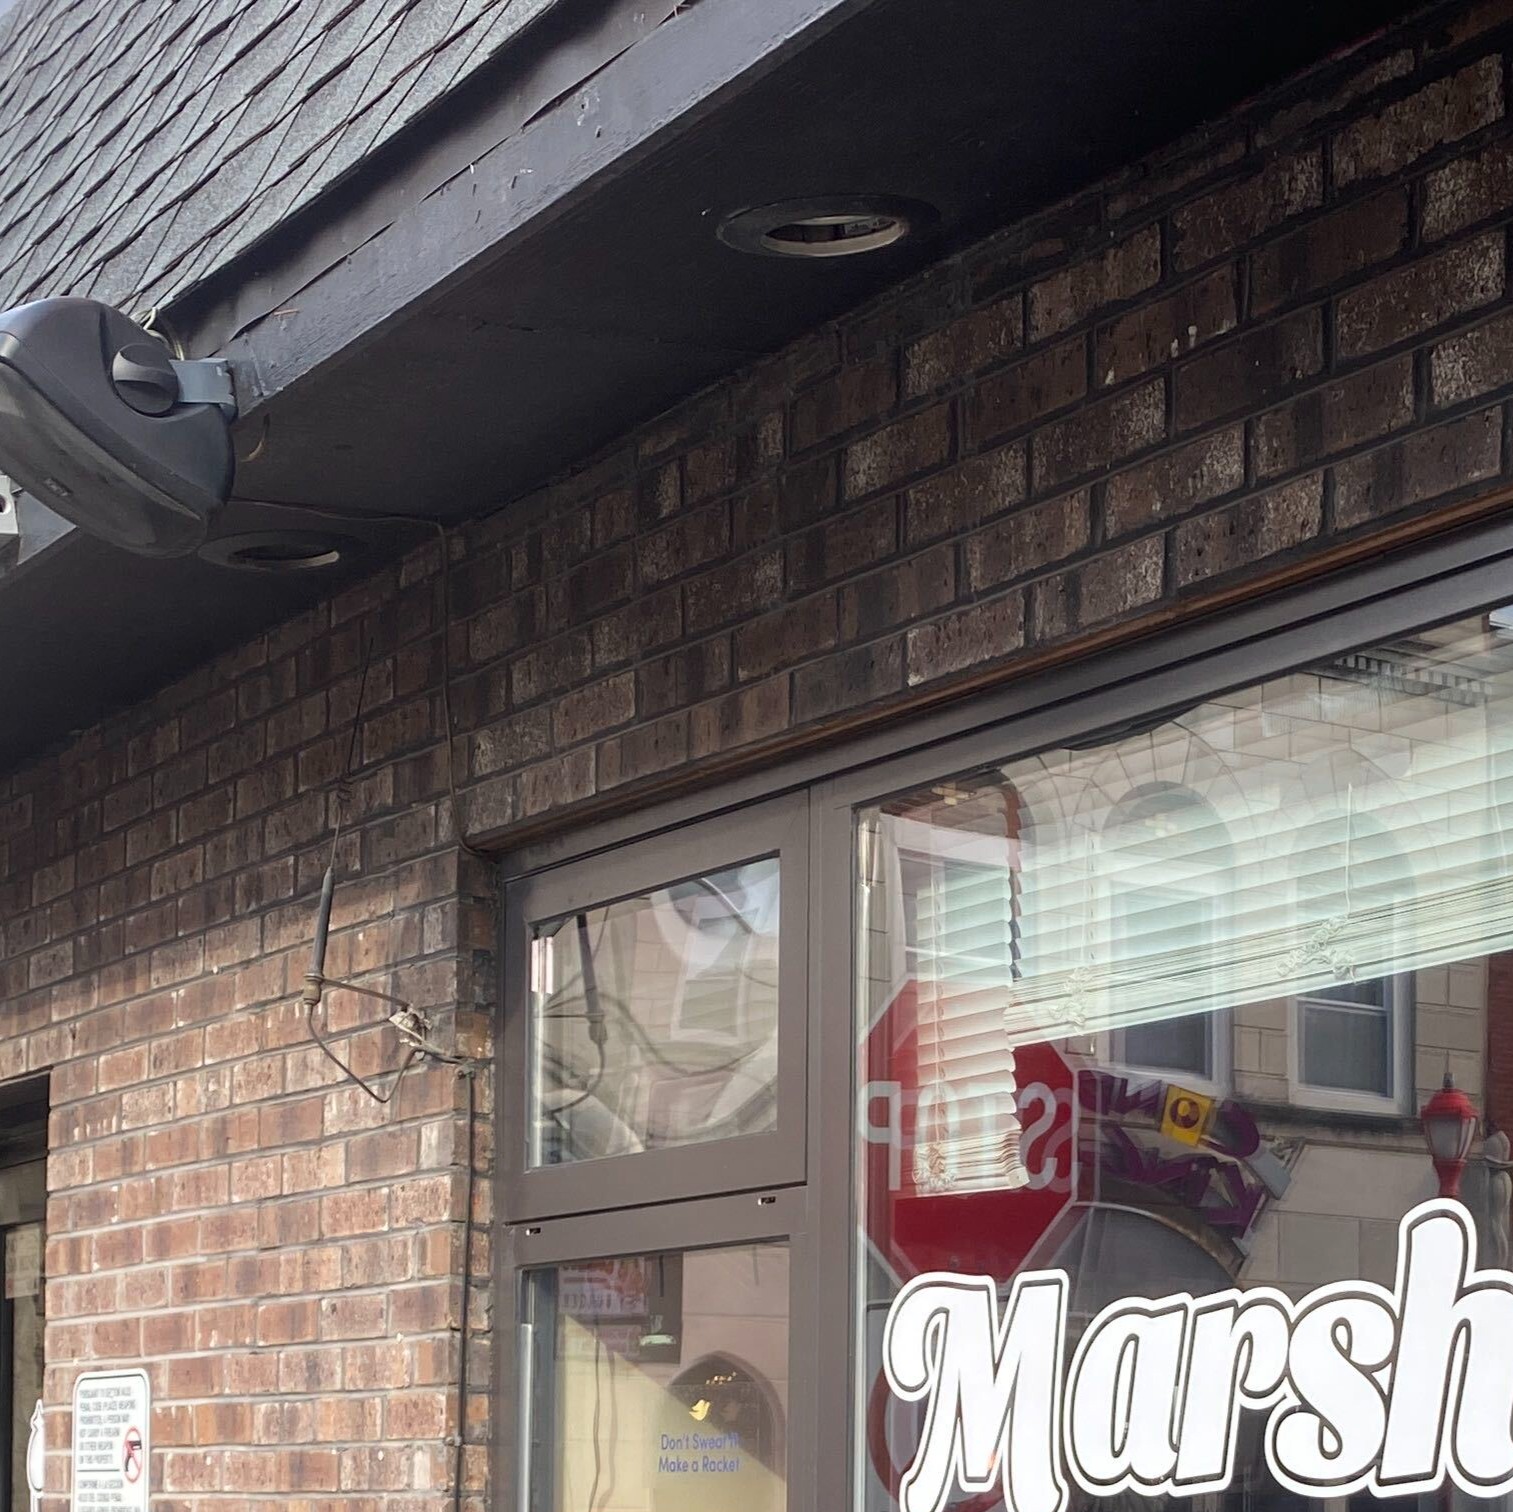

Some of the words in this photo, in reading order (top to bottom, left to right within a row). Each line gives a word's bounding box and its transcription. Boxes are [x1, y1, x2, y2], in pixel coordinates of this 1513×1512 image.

[661, 1433, 689, 1450] Don't
[692, 1433, 728, 1450] Sweat
[659, 1456, 688, 1472] Make
[692, 1461, 699, 1472] a
[702, 1456, 740, 1472] Racket
